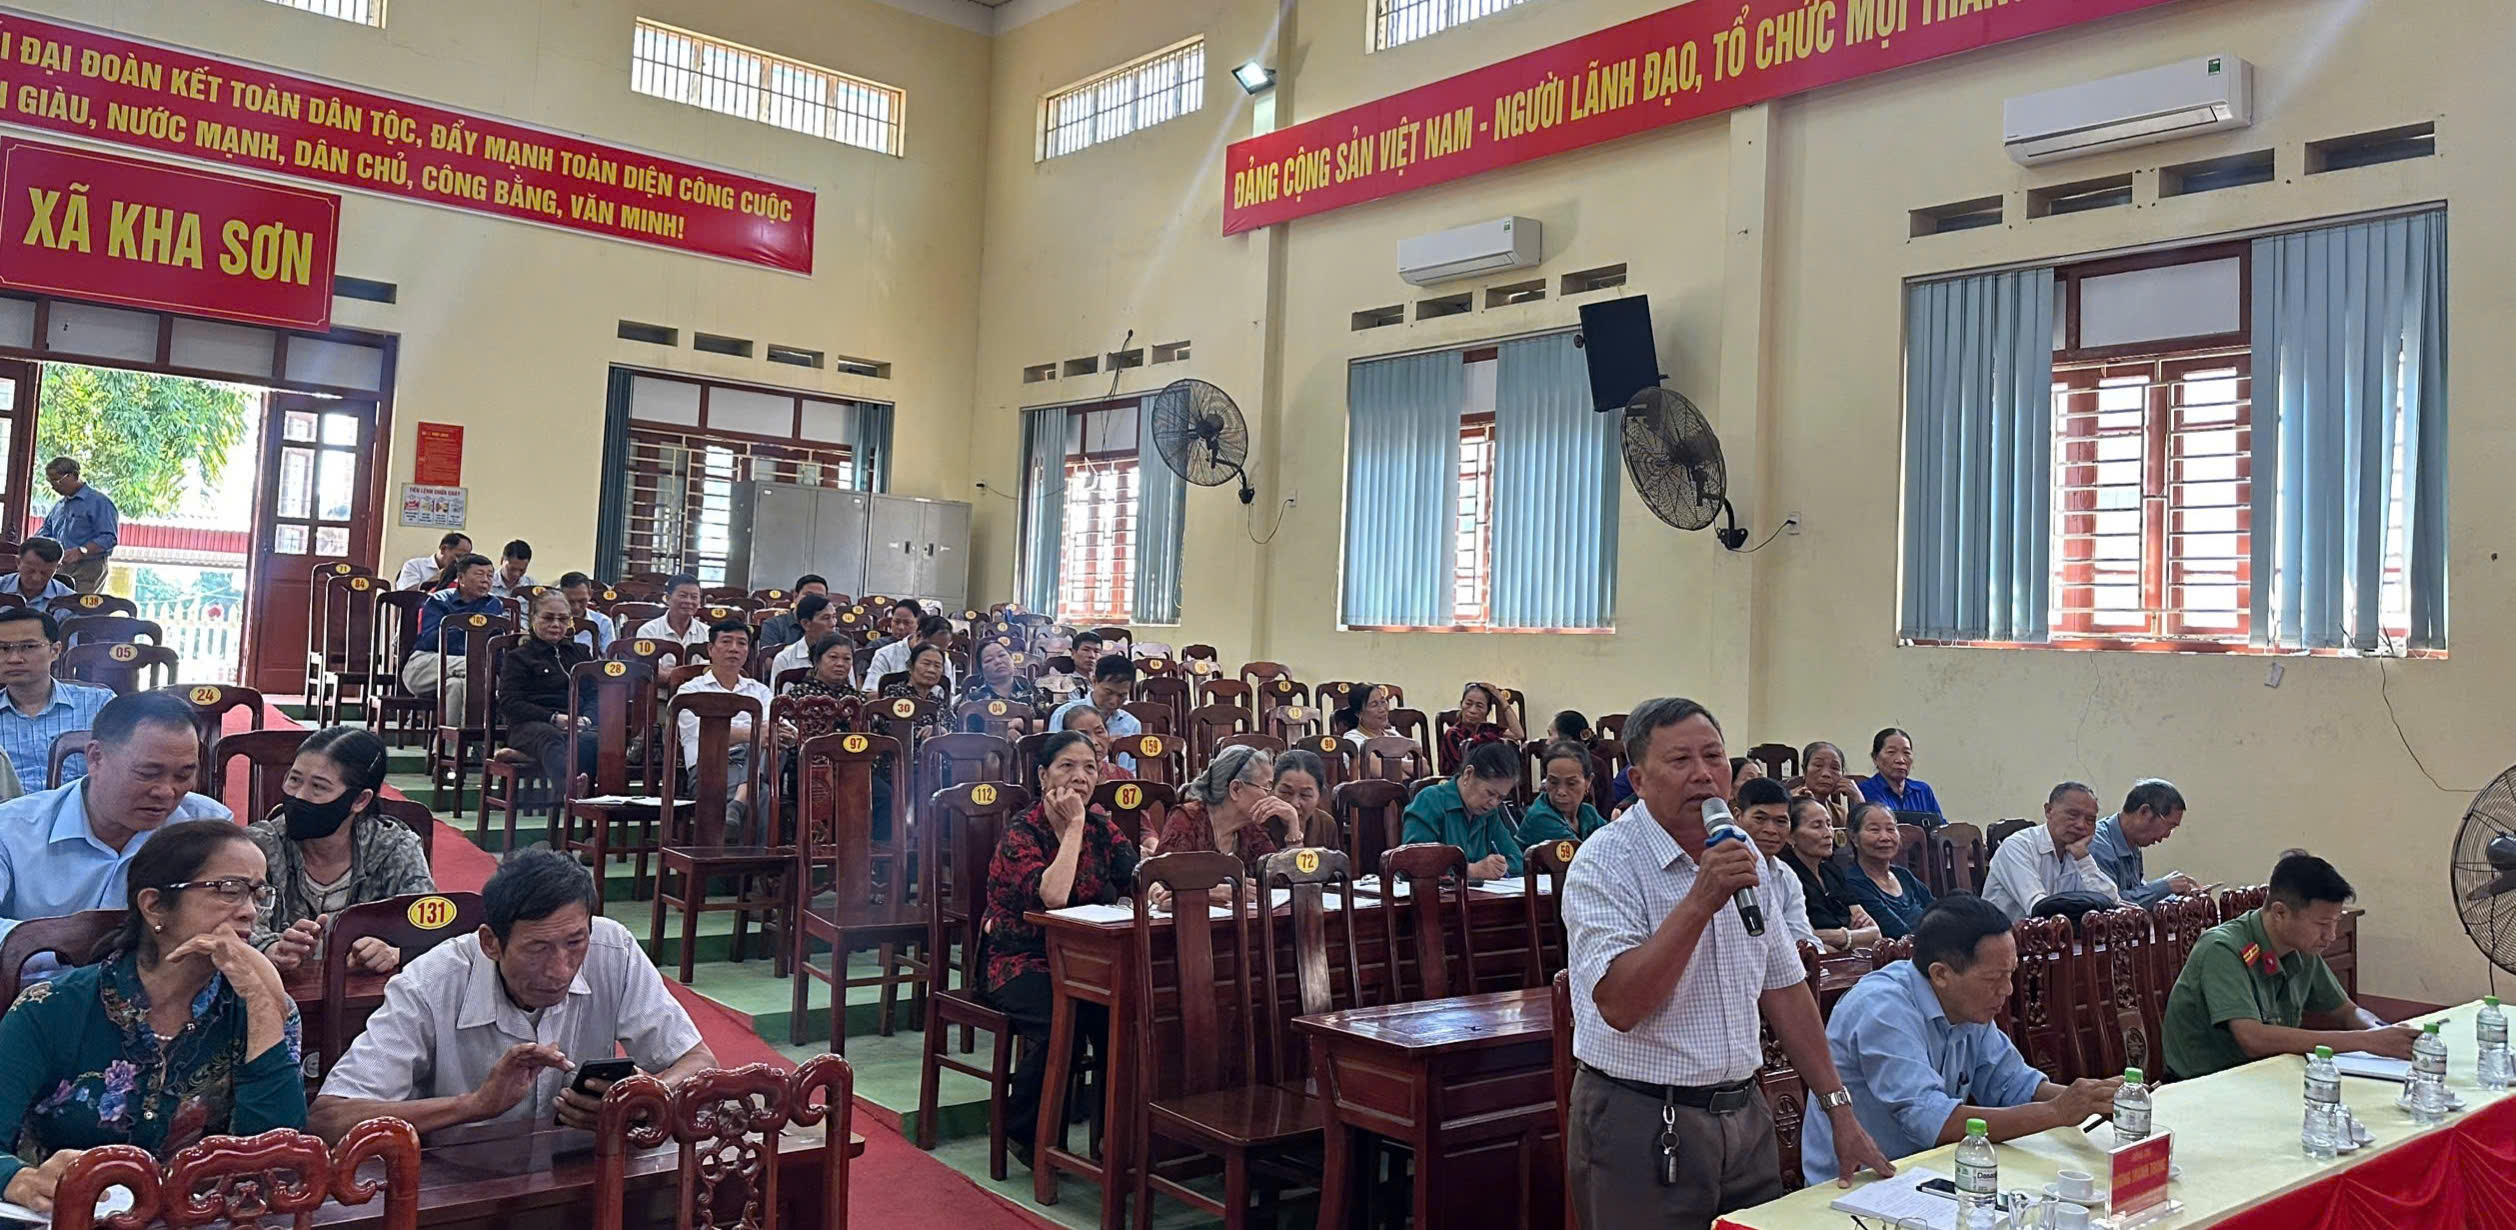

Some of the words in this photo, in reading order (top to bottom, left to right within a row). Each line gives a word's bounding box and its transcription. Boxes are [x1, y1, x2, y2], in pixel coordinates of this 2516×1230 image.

[1233, 155, 1279, 210] ĐẢNG
[1282, 146, 1331, 202] CỘNG
[1335, 125, 1375, 184] SẢN
[1379, 116, 1420, 176] VIỆT
[1424, 106, 1473, 161] NAM
[1479, 122, 1488, 132] -
[1493, 71, 1565, 141] NGƯỜI
[1570, 59, 1636, 121] LÃNH
[1643, 40, 1703, 106] ĐẠO,
[1713, 4, 1750, 82] TỔ
[20, 36, 72, 75] ĐẠI
[80, 48, 162, 92] ĐOÀN
[170, 66, 223, 103] KẾT
[230, 80, 301, 120] TOÀN
[308, 97, 363, 133] DÂN
[370, 109, 423, 148] TỘC,
[430, 119, 478, 156] ĐẨY
[484, 135, 554, 172] MẠNH
[560, 152, 618, 186] TOÀN
[623, 165, 673, 199] DIỆN
[679, 176, 735, 211] CÔNG
[740, 192, 793, 224] CUỘC
[18, 85, 97, 130] GIÀU,
[107, 102, 187, 143] NƯỚC
[195, 120, 286, 165] MẠNH,
[294, 138, 349, 175] DÂN
[356, 151, 414, 190] CHỦ,
[422, 163, 488, 201] CÔNG
[494, 174, 563, 218] BẰNG,
[570, 193, 614, 226] VĂN
[620, 204, 685, 240] MINH!
[22, 182, 91, 254] XÃ
[107, 200, 203, 270] KHA
[219, 219, 313, 286] SƠN
[115, 647, 131, 658] 05
[638, 642, 651, 652] 10
[609, 664, 621, 673] 28
[197, 689, 214, 701] 24
[897, 703, 910, 713] 30
[850, 737, 862, 749] 97
[977, 788, 992, 802] 112
[1122, 788, 1136, 805] 87
[1560, 846, 1570, 858] 59
[1301, 854, 1314, 868] 72
[417, 901, 446, 924] 131
